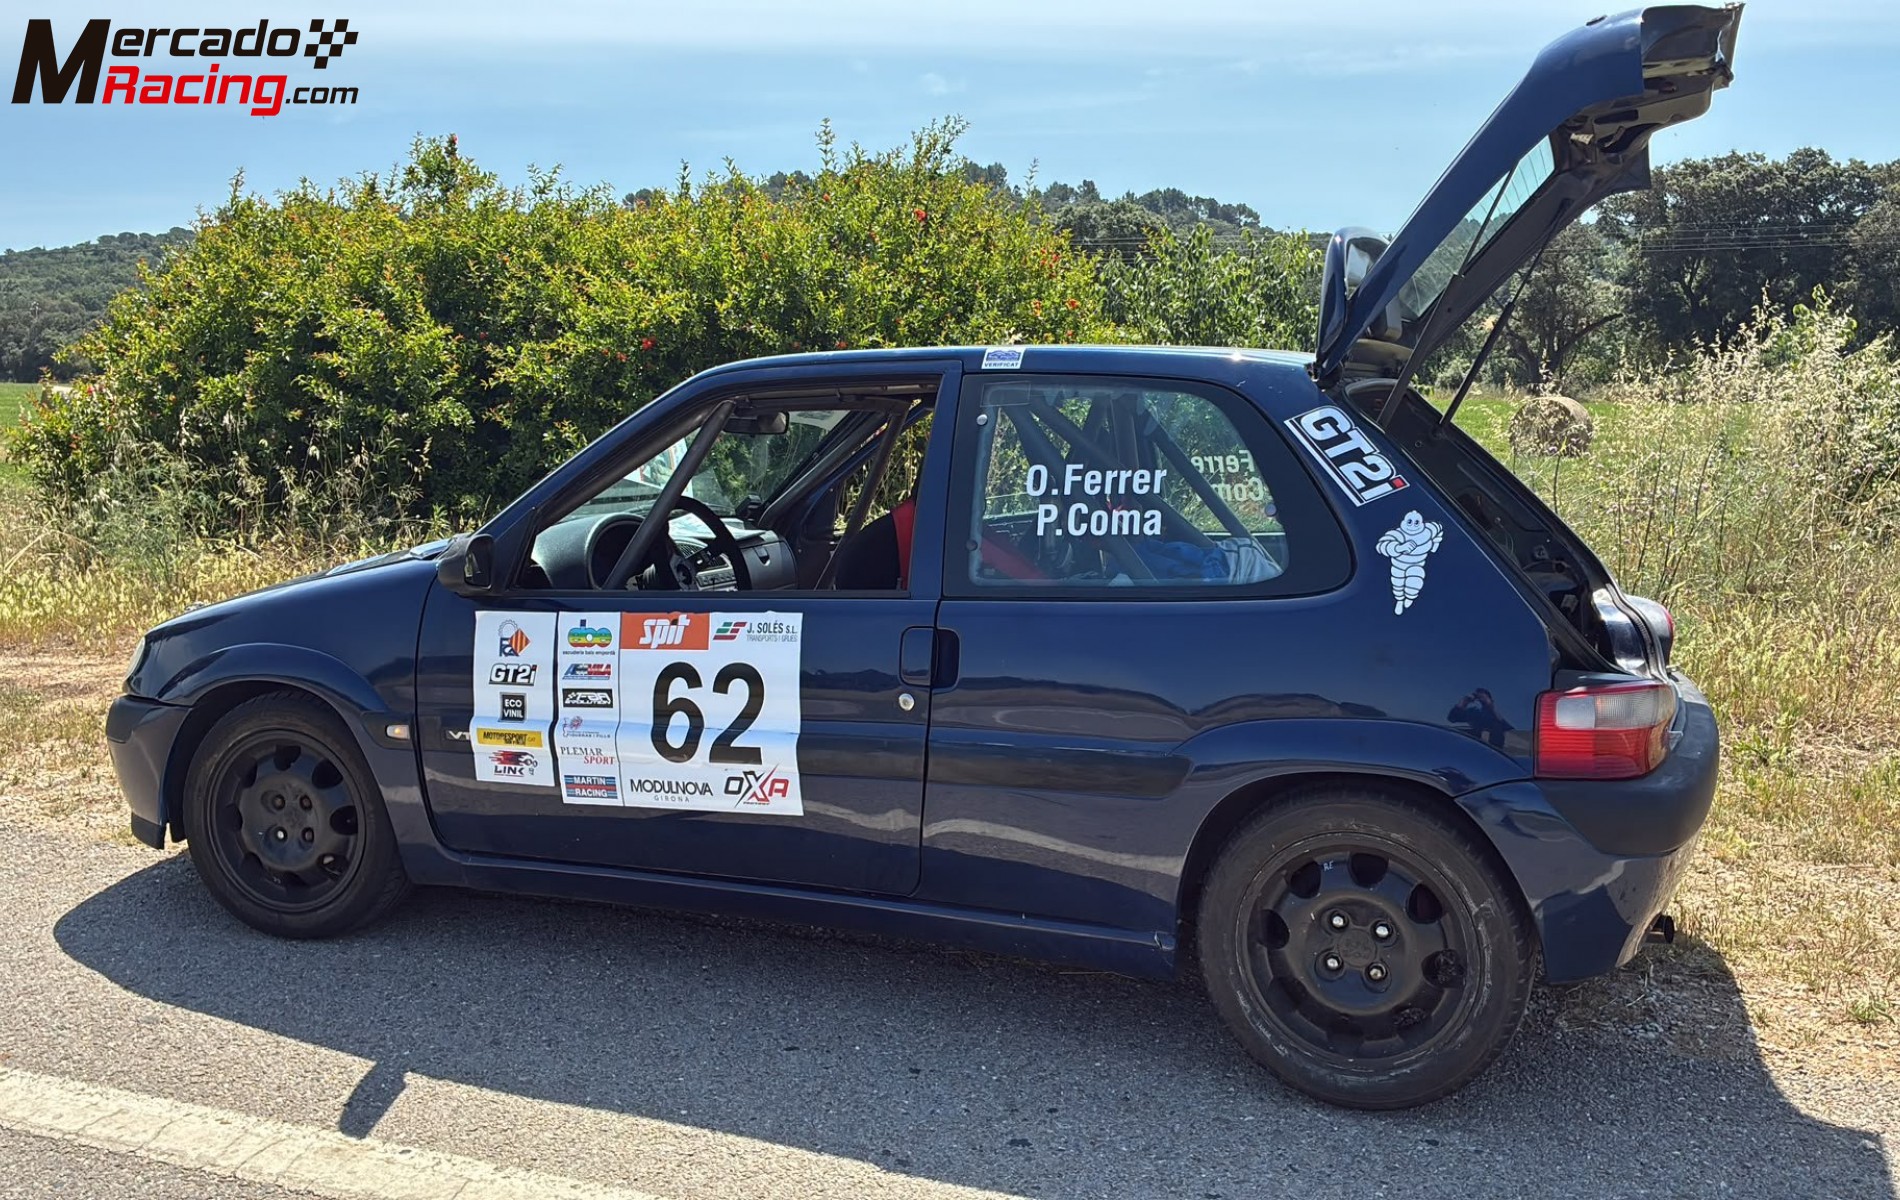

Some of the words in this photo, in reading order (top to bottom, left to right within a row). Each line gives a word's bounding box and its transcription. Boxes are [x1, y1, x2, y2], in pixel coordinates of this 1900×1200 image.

[1300, 406, 1406, 501] GT2i
[1026, 464, 1167, 497] O.Ferrer
[1036, 502, 1162, 536] P.Coma
[639, 614, 691, 649] spit
[746, 622, 755, 634] J.
[757, 620, 784, 634] SOLÉS
[490, 663, 538, 684] GT2i
[504, 699, 523, 708] ECO
[503, 709, 524, 718] VINIL
[651, 661, 765, 765] 62
[560, 746, 604, 756] PLEMAR
[583, 755, 616, 766] SPORT
[493, 765, 525, 776] LINK
[573, 776, 607, 786] MARTIN
[575, 788, 609, 798] RACING
[629, 779, 714, 797] MODULNOVA
[654, 795, 690, 803] GIRONA
